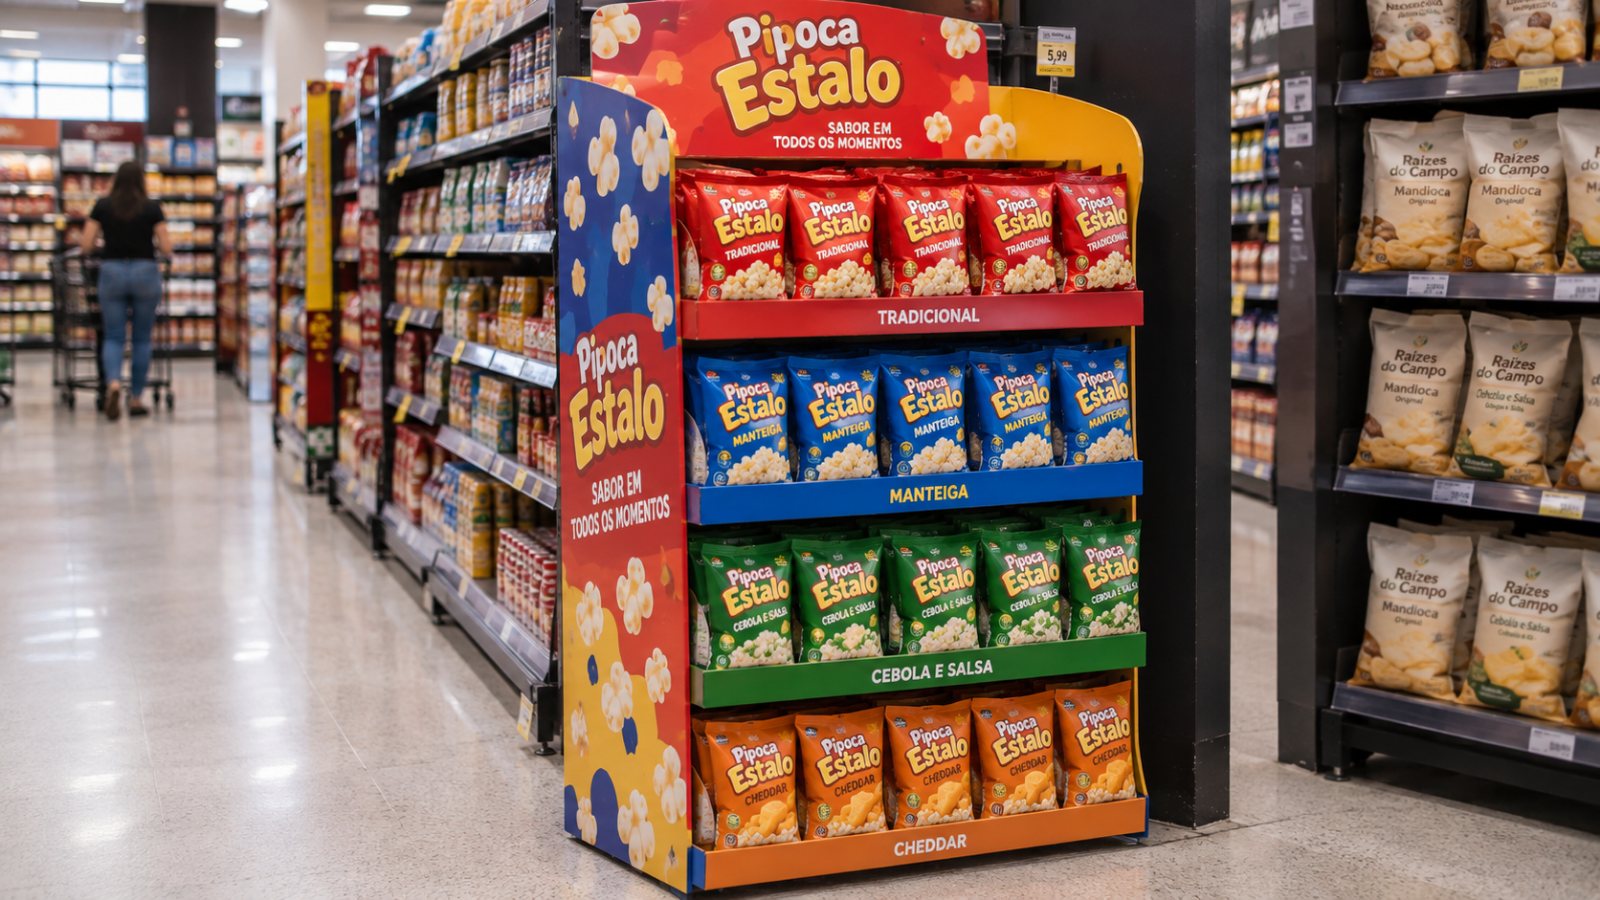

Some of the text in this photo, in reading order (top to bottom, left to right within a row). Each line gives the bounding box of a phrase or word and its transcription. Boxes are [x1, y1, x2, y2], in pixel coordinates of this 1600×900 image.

[728, 14, 858, 65] Pipoca
[1047, 49, 1067, 65] 5,99
[716, 46, 900, 131] Estalo
[828, 121, 891, 135] SABOR EM
[774, 136, 902, 150] TODOS OS MOMENTOS
[1390, 166, 1458, 179] do Campo
[1479, 163, 1550, 178] do Campo
[1394, 186, 1451, 197] Mandioca
[1482, 184, 1542, 196] Mandioca
[720, 198, 768, 218] Pipoca
[809, 201, 855, 220] Pipoca
[907, 199, 949, 218] Pipoca
[997, 198, 1038, 216] Pipoca
[1077, 196, 1113, 214] Pipoca
[714, 208, 783, 245] Estalo
[804, 211, 871, 245] Estalo
[903, 208, 964, 242] Estalo
[994, 207, 1052, 241] Estalo
[1076, 205, 1127, 237] Estalo
[878, 307, 980, 325] TRADICIONAL
[577, 334, 638, 393] Pipoca
[1381, 360, 1447, 379] do Campo
[994, 373, 1035, 395] Pipoca
[1077, 370, 1114, 391] Pipoca
[1476, 365, 1544, 386] do Campo
[723, 381, 770, 403] Pipoca
[813, 380, 859, 402] Pipoca
[904, 376, 948, 398] Pipoca
[1075, 379, 1128, 416] Estalo
[1383, 382, 1439, 397] Mandioca
[717, 391, 786, 432] Estalo
[808, 389, 875, 429] Estalo
[901, 385, 963, 424] Estalo
[991, 382, 1049, 419] Estalo
[569, 367, 665, 471] Estalo
[914, 415, 960, 438] MANTEIGA
[733, 424, 782, 447] MANTEIGA
[822, 420, 871, 443] MANTEIGA
[592, 469, 642, 505] SABOR EM
[889, 484, 969, 504] MANTEIGA
[571, 494, 670, 540] TODOS OS MOMENTOS
[1004, 551, 1045, 572] Pipoca
[1085, 546, 1124, 565] Pipoca
[726, 566, 774, 588] Pipoca
[816, 562, 862, 583] Pipoca
[916, 557, 959, 578] Pipoca
[1001, 560, 1060, 597] Estalo
[1083, 555, 1139, 590] Estalo
[811, 571, 878, 610] Estalo
[912, 566, 975, 603] Estalo
[1117, 587, 1122, 595] E
[1380, 578, 1447, 599] do Campo
[722, 576, 789, 617] Estalo
[949, 600, 955, 609] E
[1036, 594, 1041, 603] E
[1489, 592, 1558, 614] do Campo
[763, 612, 768, 622] E
[849, 607, 855, 616] E
[1382, 601, 1439, 619] Mandioca
[871, 659, 993, 684] CEBOLA E SALSA
[995, 717, 1038, 738] Pipoca
[1078, 706, 1118, 728] Pipoca
[820, 734, 865, 757] Pipoca
[910, 725, 953, 747] Pipoca
[992, 727, 1052, 766] Estalo
[1076, 717, 1130, 755] Estalo
[731, 742, 778, 765] Pipoca
[906, 735, 968, 775] Estalo
[1092, 744, 1127, 766] CHEDDAR
[727, 754, 794, 794] Estalo
[816, 745, 881, 786] Estalo
[1009, 755, 1047, 776] CHEDDAR
[744, 783, 788, 806] CHEDDAR
[834, 775, 876, 797] CHEDDAR
[894, 833, 967, 857] CHEDDAR
